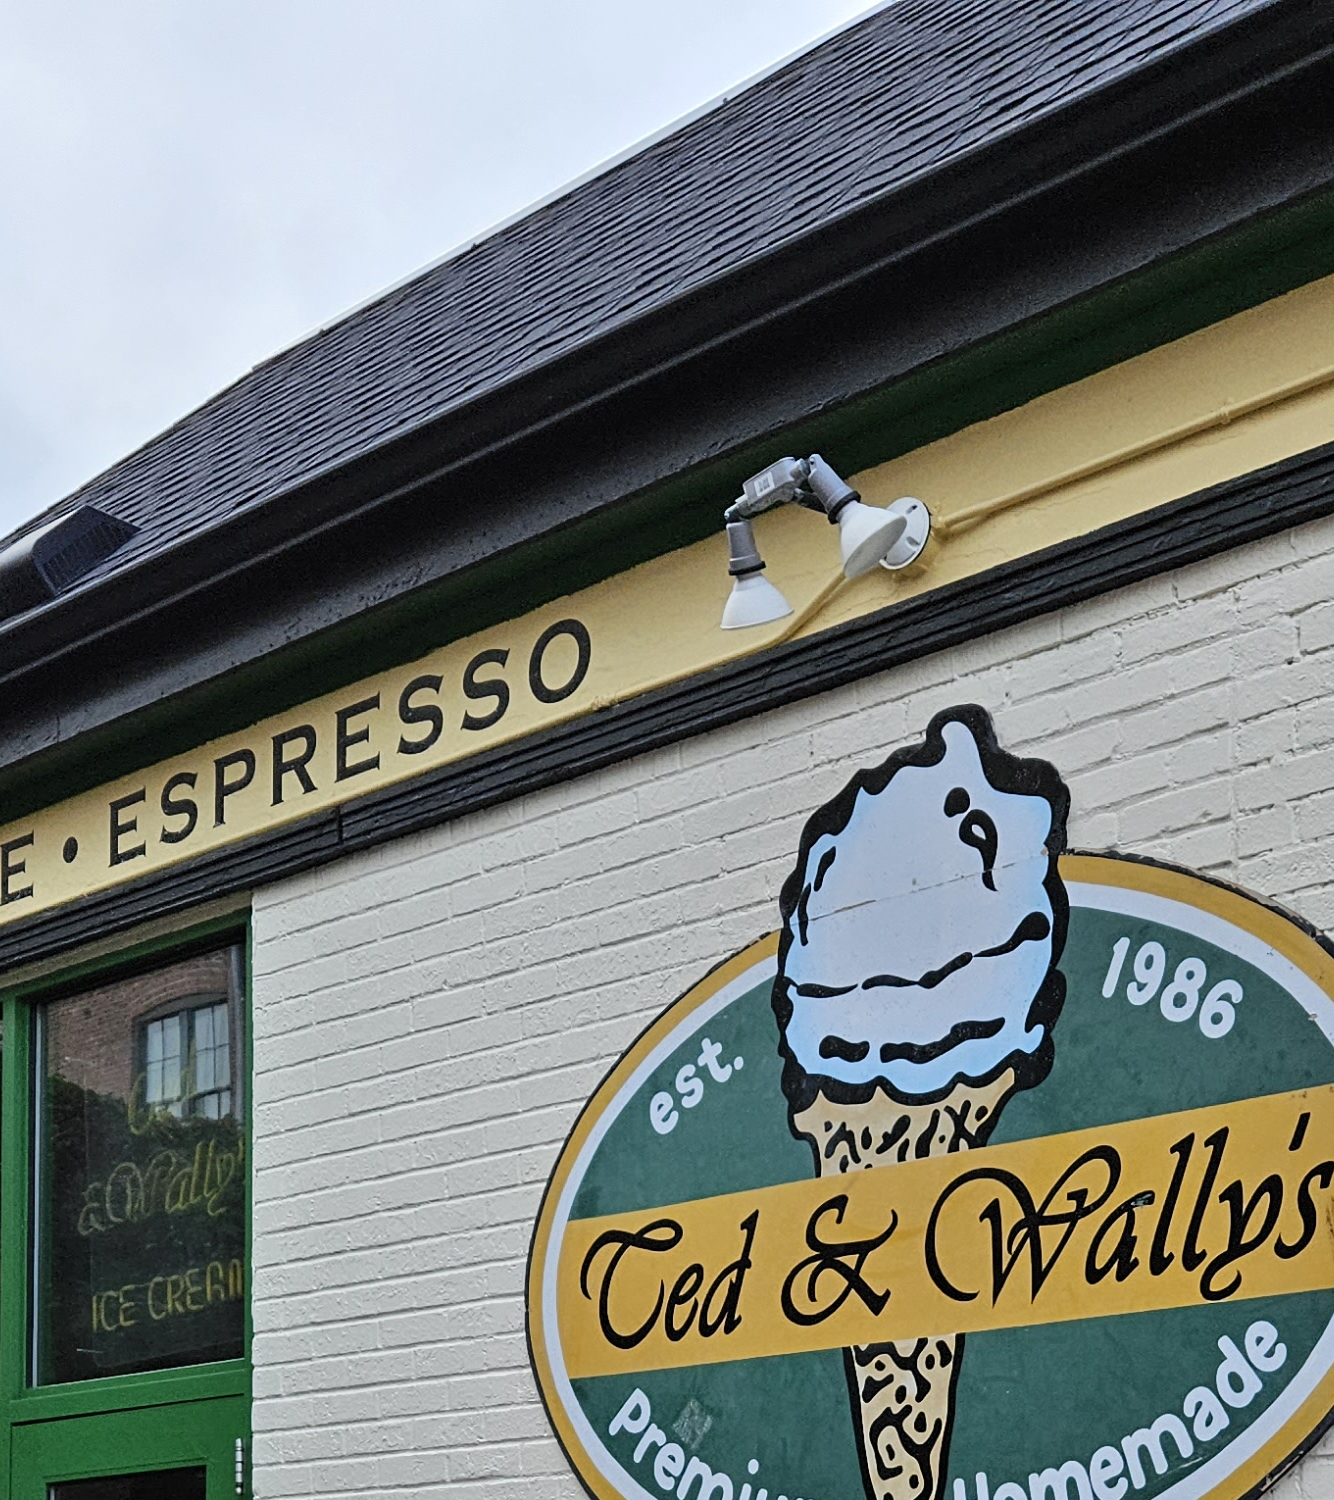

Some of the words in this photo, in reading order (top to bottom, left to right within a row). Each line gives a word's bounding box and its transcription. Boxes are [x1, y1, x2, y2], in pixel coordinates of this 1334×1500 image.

[108, 618, 592, 868] ESPRESSO
[1102, 936, 1244, 1039] 1986
[649, 1034, 745, 1135] est.
[92, 1284, 136, 1332] ICE
[579, 1210, 760, 1351] Ted
[781, 1194, 901, 1326] &
